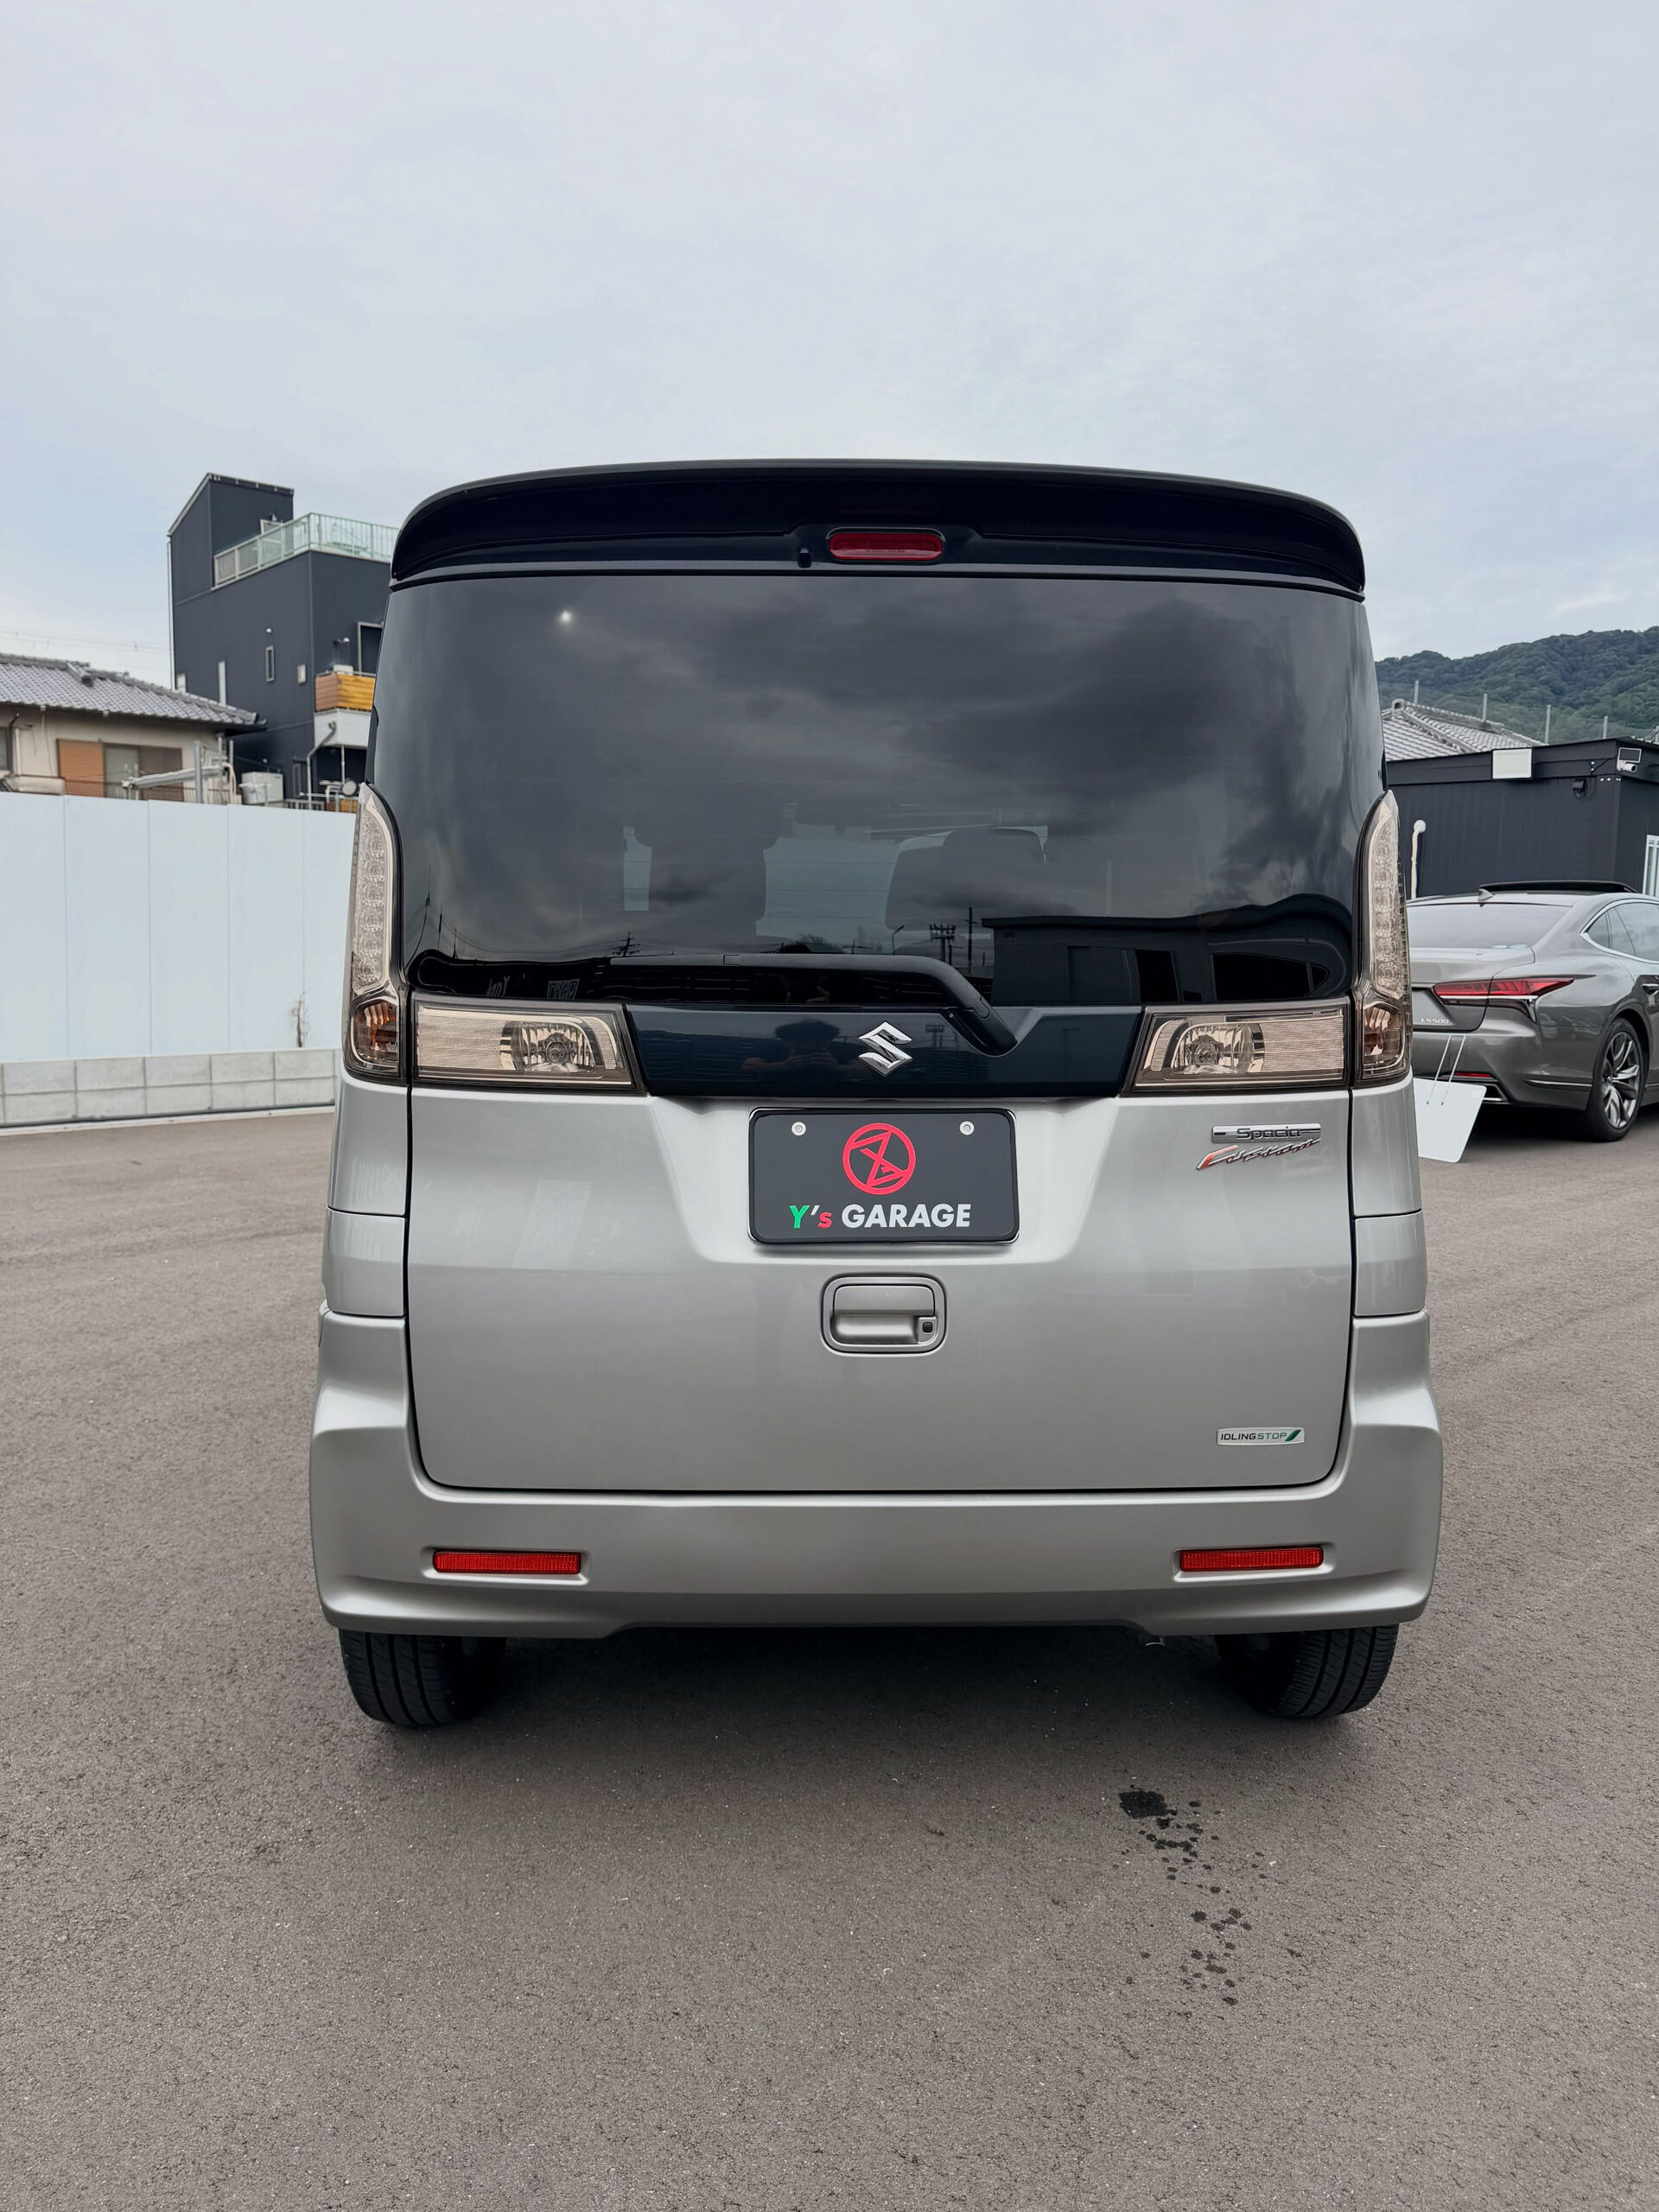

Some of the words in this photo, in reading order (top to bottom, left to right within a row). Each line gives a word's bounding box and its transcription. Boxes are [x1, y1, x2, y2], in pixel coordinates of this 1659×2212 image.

[1236, 1126, 1300, 1141] Spacia
[789, 1205, 832, 1229] Y's
[841, 1204, 971, 1228] GARAGE
